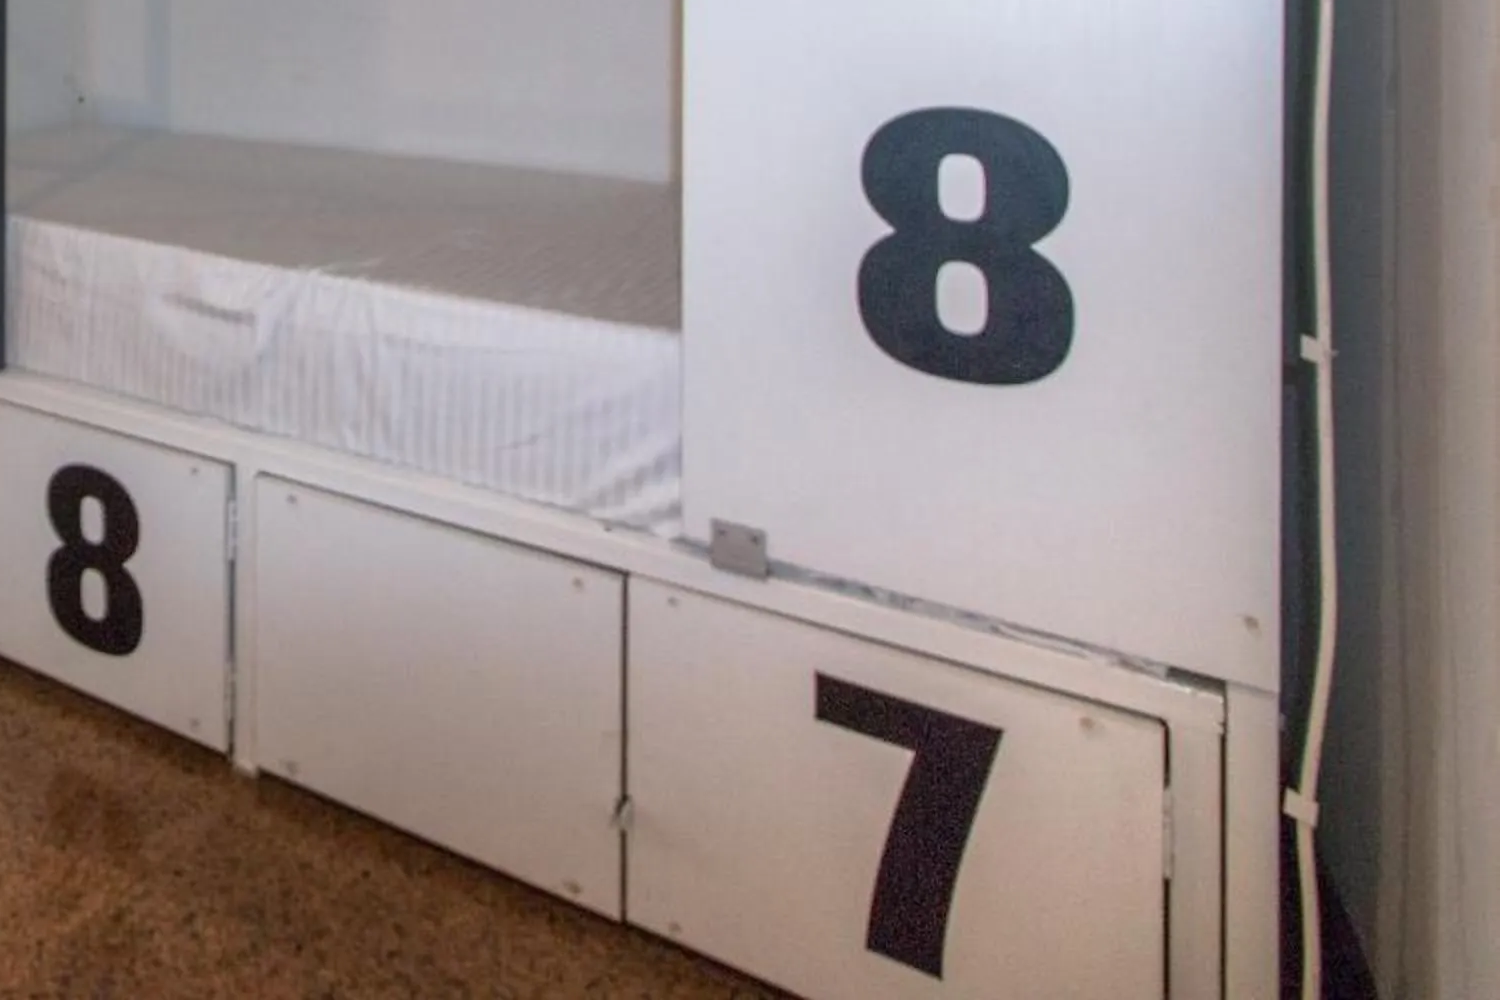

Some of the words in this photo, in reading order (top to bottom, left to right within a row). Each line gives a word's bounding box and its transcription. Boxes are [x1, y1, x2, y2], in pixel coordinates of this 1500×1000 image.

[858, 107, 1074, 385] 8
[45, 463, 145, 658] 8
[814, 671, 1004, 983] 7
